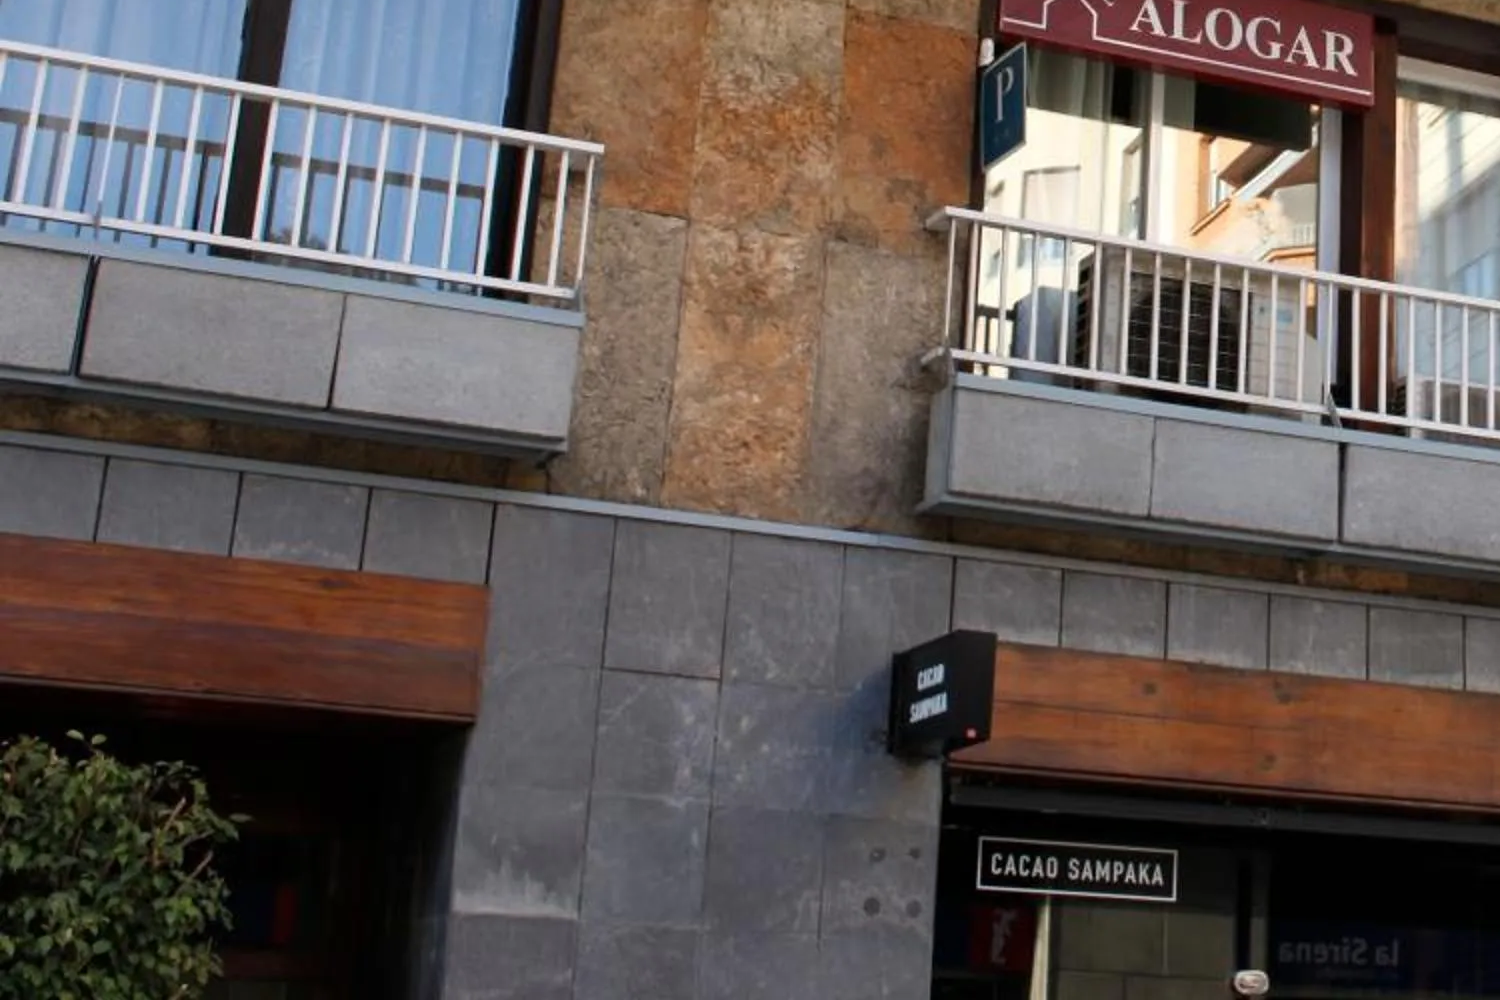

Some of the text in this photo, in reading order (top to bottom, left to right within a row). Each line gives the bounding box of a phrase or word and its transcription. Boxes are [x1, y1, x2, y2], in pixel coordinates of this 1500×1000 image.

[995, 66, 1014, 122] P
[991, 853, 1165, 887] CACAO SAMPAKA
